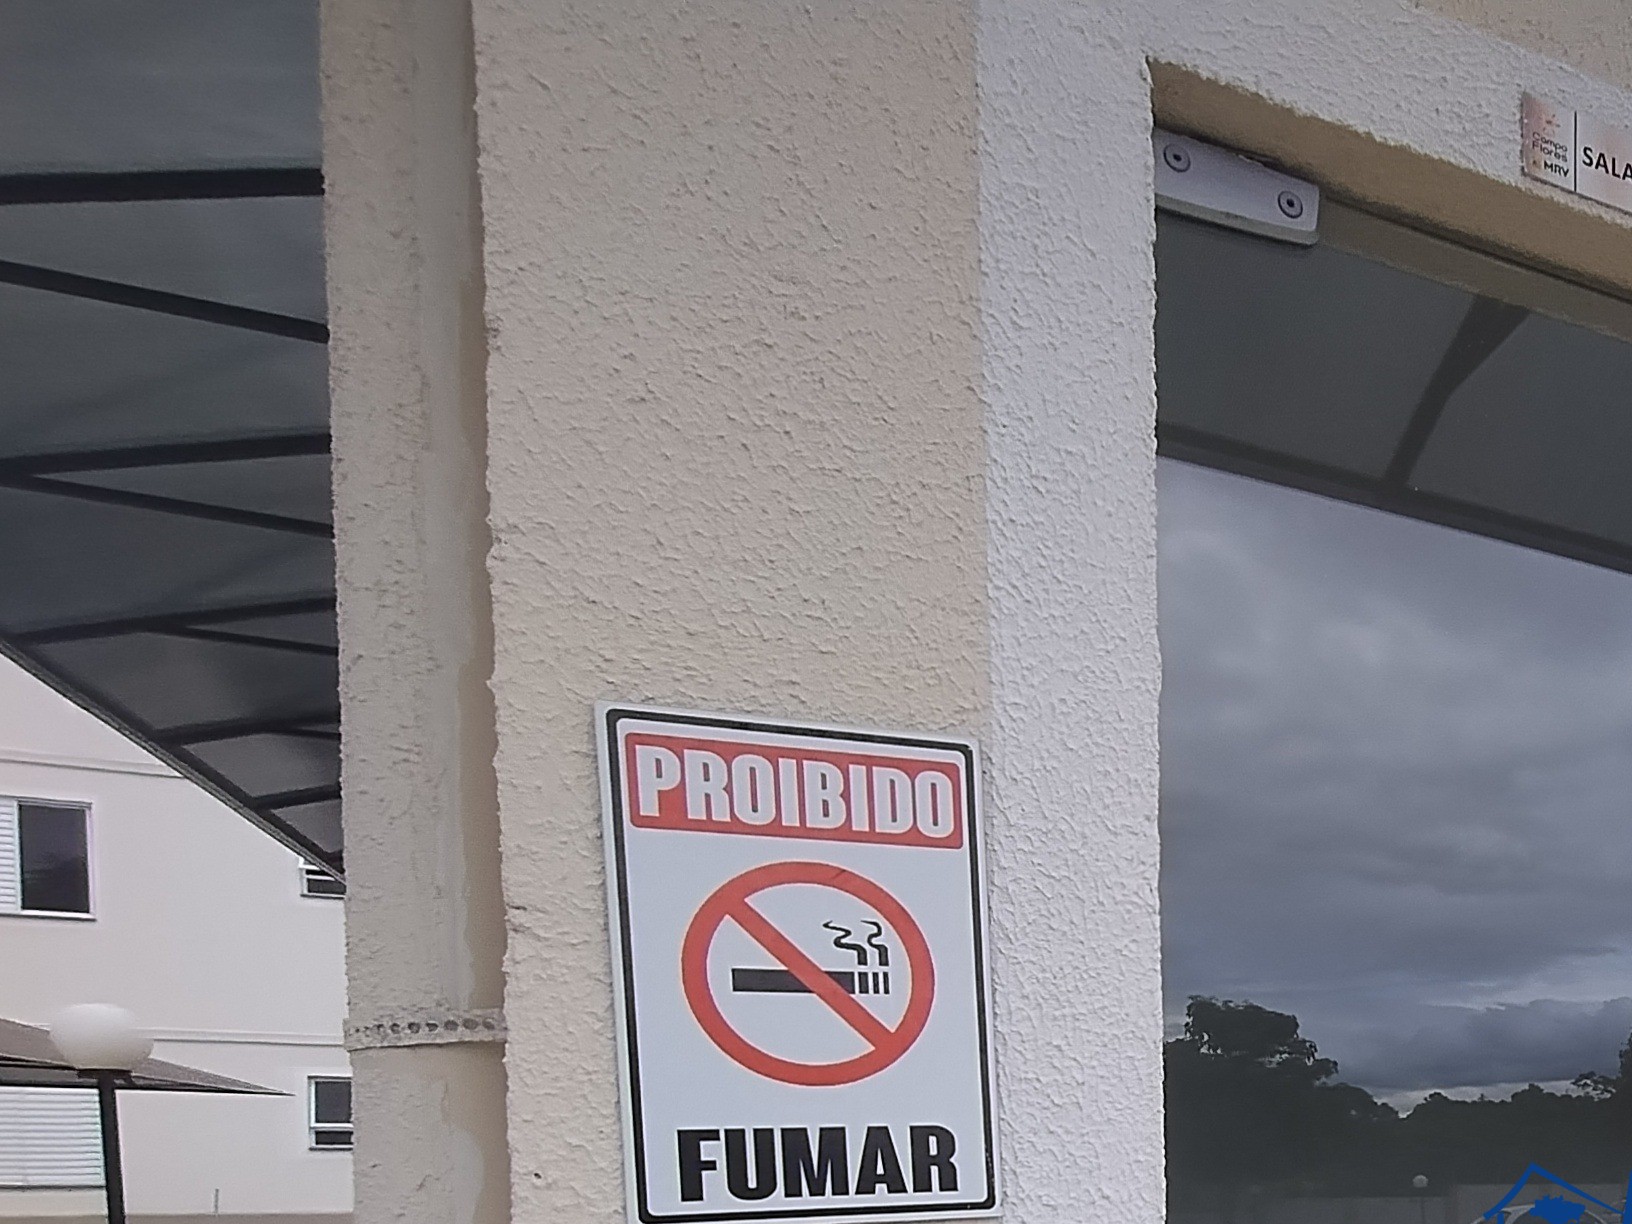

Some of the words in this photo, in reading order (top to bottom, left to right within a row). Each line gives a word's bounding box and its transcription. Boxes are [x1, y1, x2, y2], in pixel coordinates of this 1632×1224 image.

[1532, 131, 1568, 153] Campo
[1532, 141, 1568, 163] Flores
[1543, 160, 1570, 178] MRV
[634, 744, 956, 839] PROIBIDO
[676, 1124, 959, 1203] FUMAR
